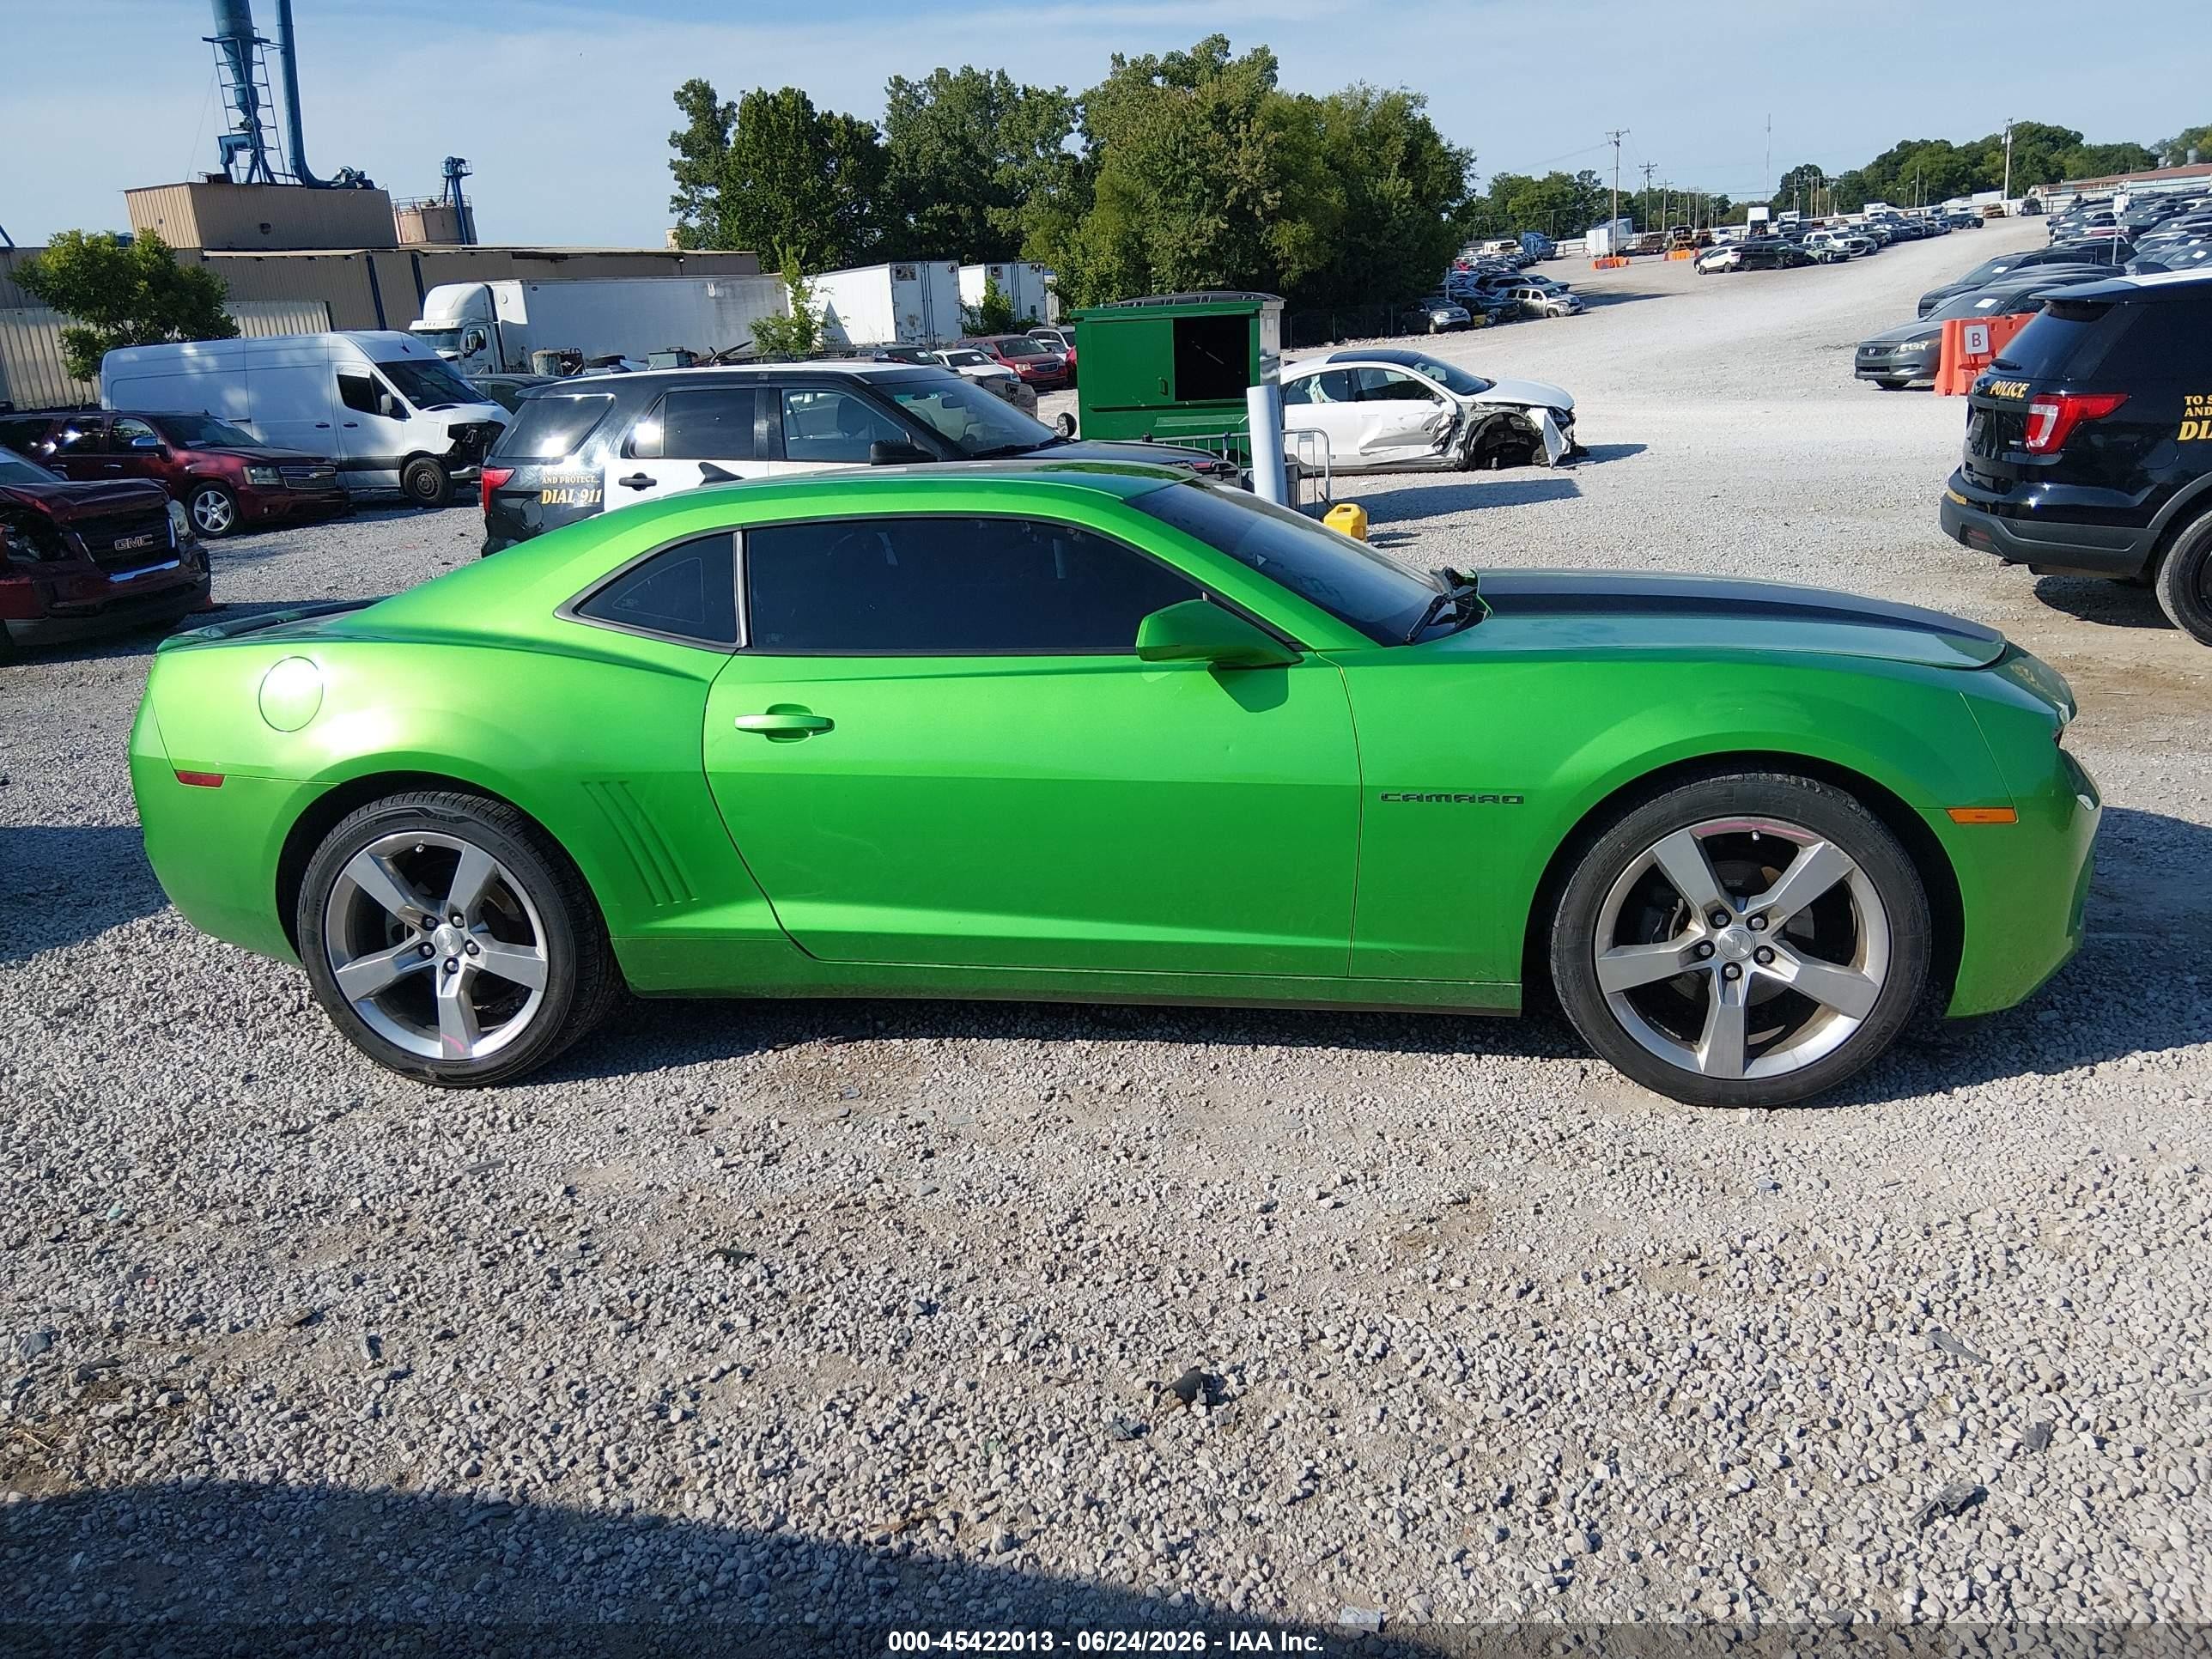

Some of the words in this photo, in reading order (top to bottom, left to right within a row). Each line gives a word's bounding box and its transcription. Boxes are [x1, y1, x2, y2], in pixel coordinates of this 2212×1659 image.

[1972, 332, 1982, 347] B
[1990, 380, 2030, 398] POLICE
[2185, 395, 2203, 405] TO
[2185, 406, 2212, 417] AND
[2178, 421, 2212, 440] DI
[541, 476, 558, 484] AND
[541, 489, 575, 504] DIAL
[580, 489, 602, 504] 911
[114, 533, 154, 550] GMC
[1381, 793, 1524, 804] CAMARO
